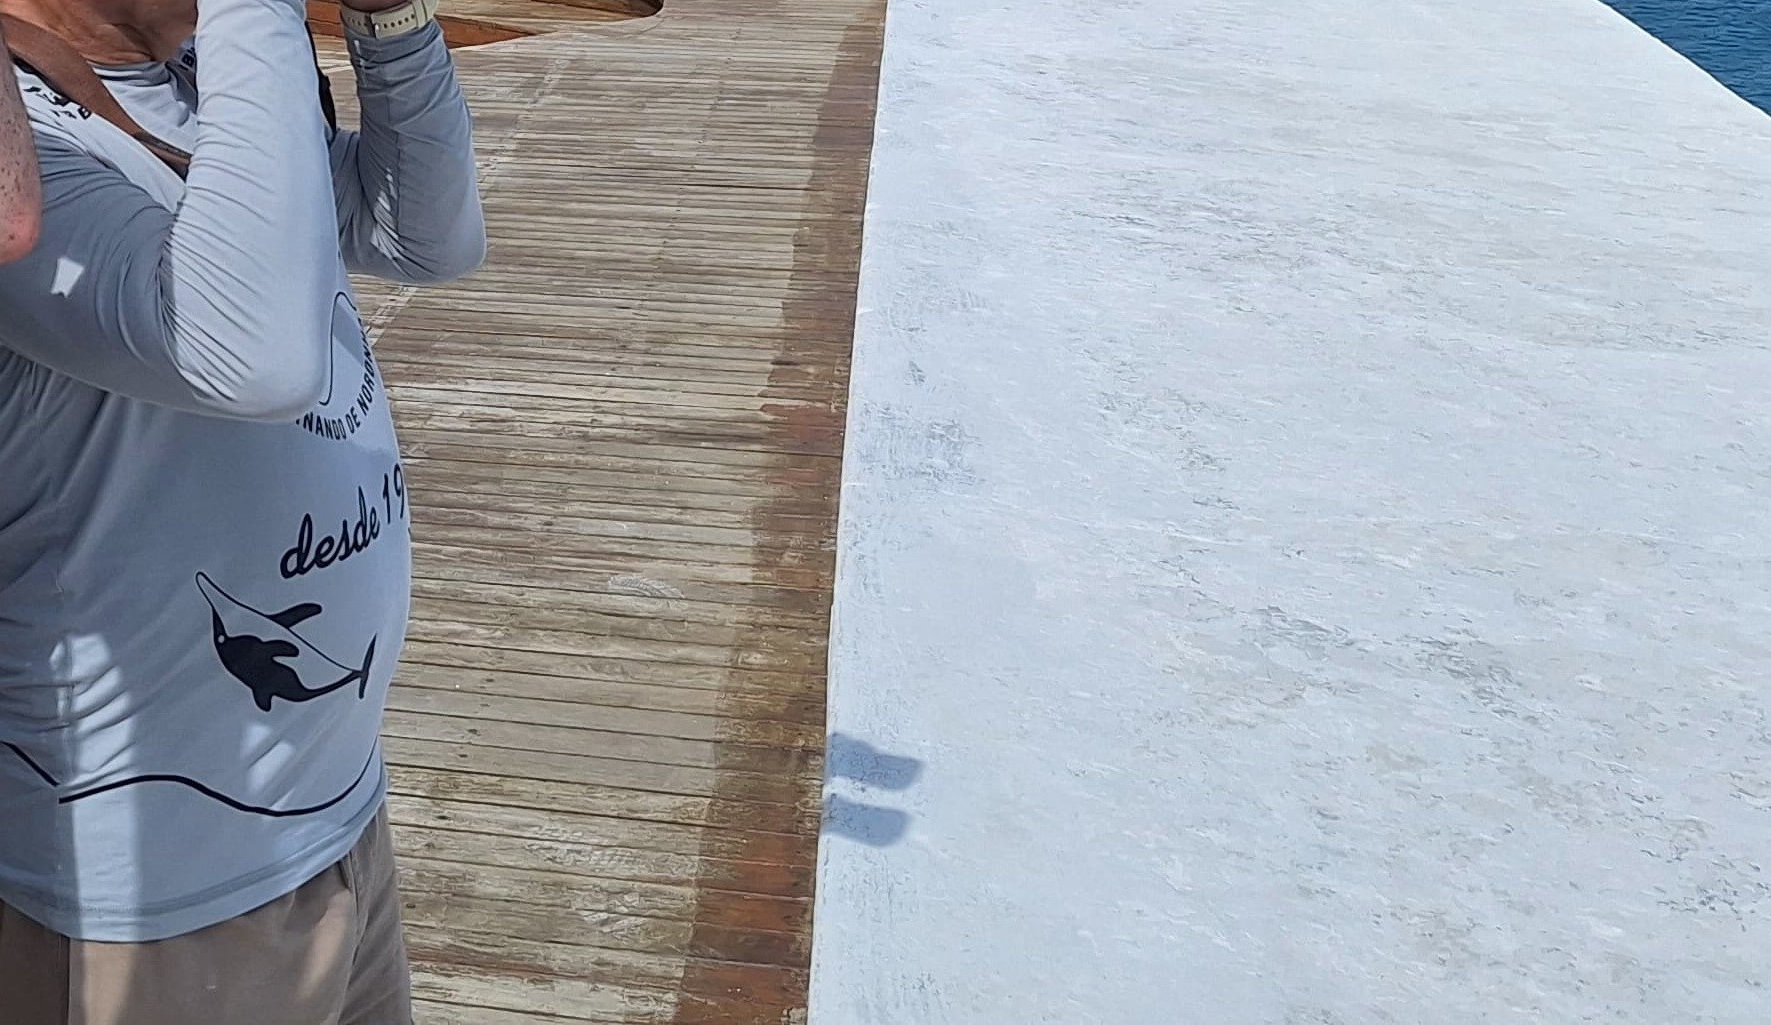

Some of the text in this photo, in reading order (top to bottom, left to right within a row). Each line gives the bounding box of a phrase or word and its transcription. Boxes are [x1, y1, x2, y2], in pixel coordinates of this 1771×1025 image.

[295, 411, 347, 440] NANDO
[345, 406, 361, 434] DE
[280, 463, 405, 579] desde 19
